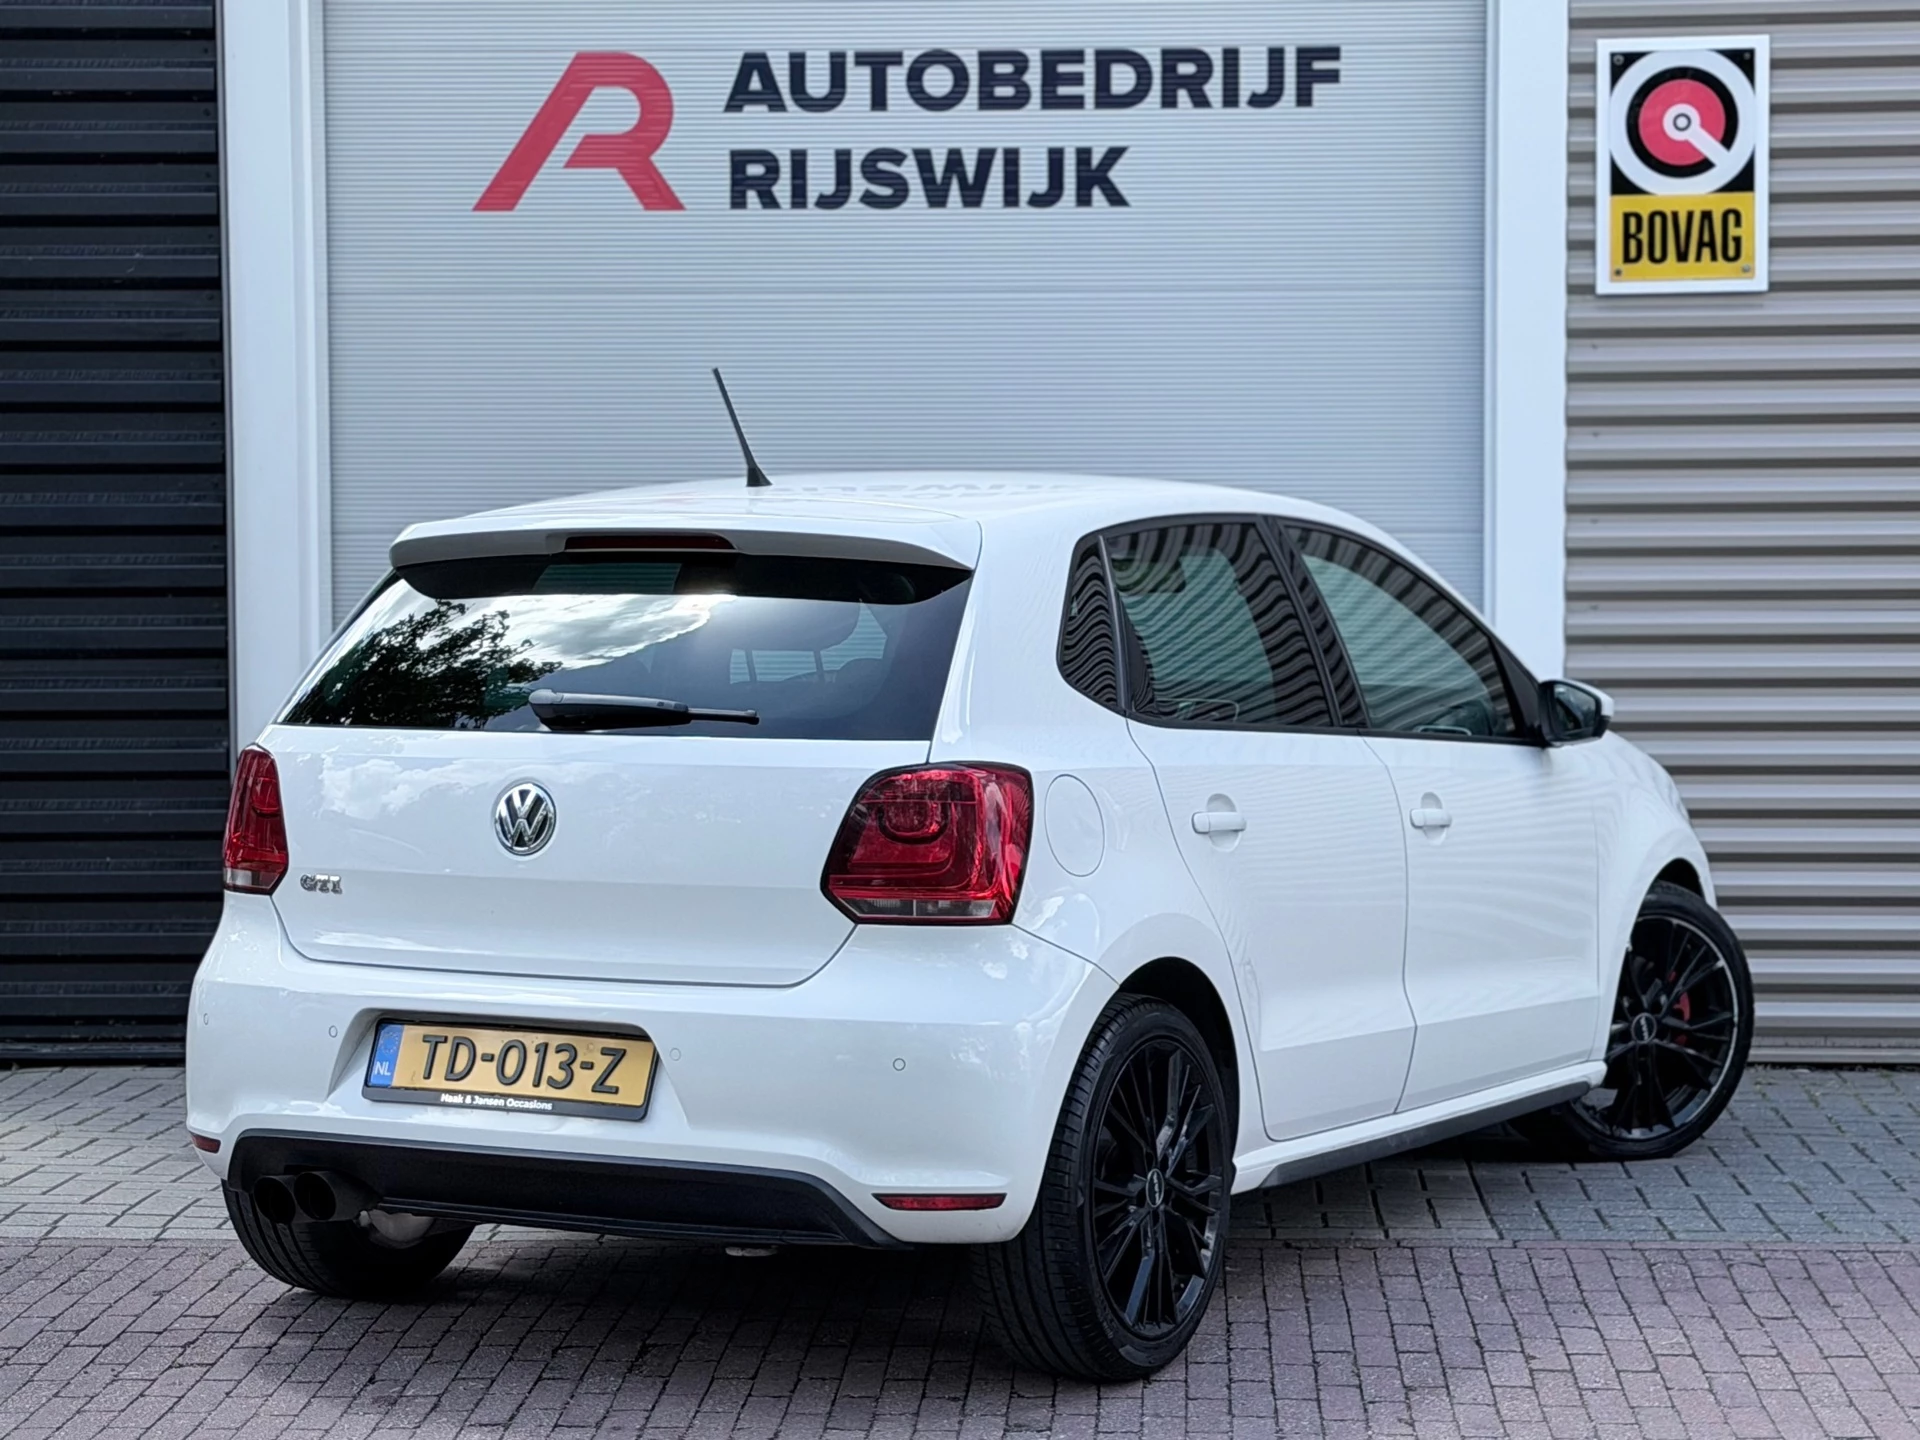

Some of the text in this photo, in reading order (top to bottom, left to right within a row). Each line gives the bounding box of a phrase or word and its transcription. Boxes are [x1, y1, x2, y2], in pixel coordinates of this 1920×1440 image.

[724, 46, 1341, 113] AUTOBEDRIJF
[730, 147, 1130, 210] RIJSWIJK
[1622, 208, 1742, 265] BOVAG
[300, 873, 342, 894] GTI
[374, 1060, 391, 1077] NL
[421, 1034, 628, 1095] TD-013-Z
[440, 1093, 553, 1111] Haak & Jansen Occasions
